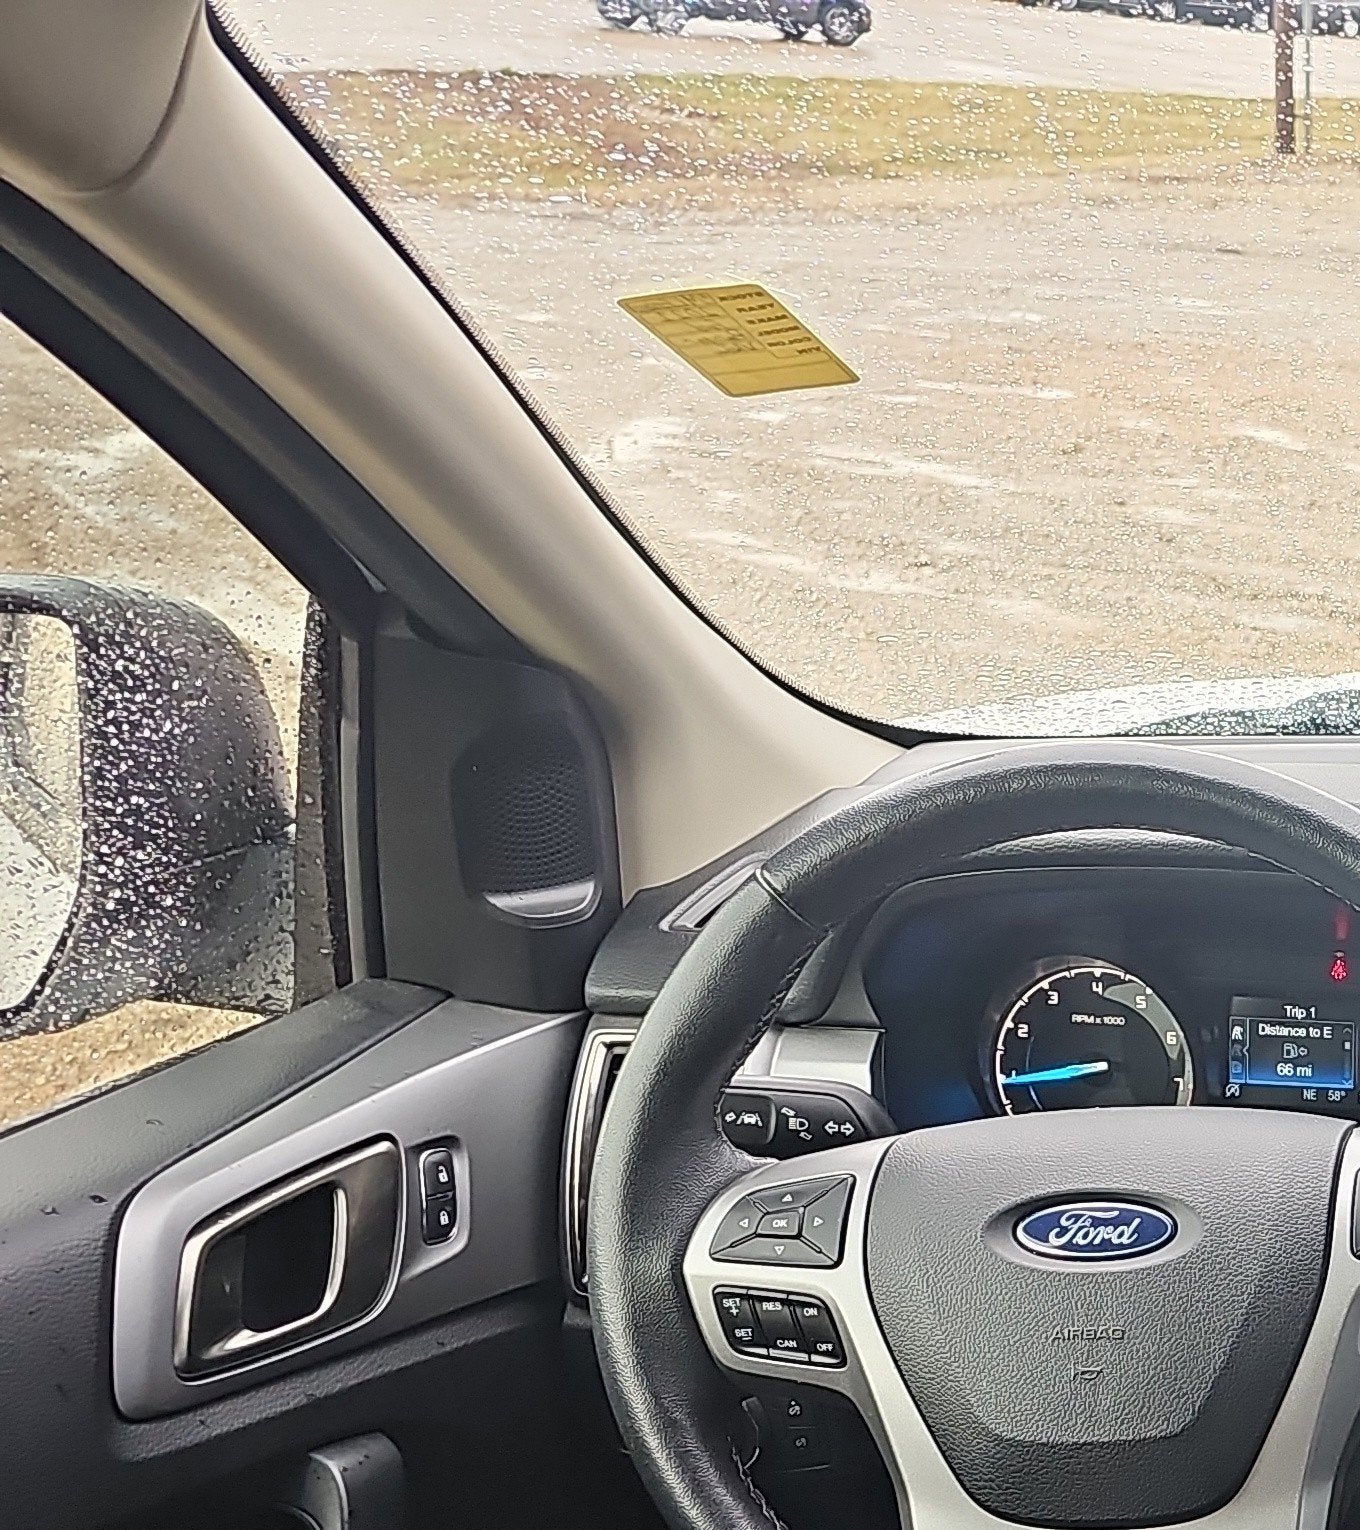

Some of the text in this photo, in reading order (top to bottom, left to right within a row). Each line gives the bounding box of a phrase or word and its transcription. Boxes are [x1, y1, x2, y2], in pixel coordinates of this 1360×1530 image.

[1092, 981, 1103, 996] 4
[1048, 991, 1059, 1005] 3
[1135, 995, 1147, 1009] 5
[1284, 1005, 1316, 1020] Trip 1
[1071, 1014, 1095, 1024] RPM
[1102, 1016, 1126, 1026] 1000
[1017, 1024, 1029, 1038] 2
[1258, 1023, 1333, 1038] Distance to E
[1166, 1031, 1177, 1045] 6
[1276, 1063, 1313, 1077] 66 mi
[1174, 1077, 1184, 1091] 7
[1303, 1089, 1317, 1101] NE
[772, 1219, 789, 1228] OK
[1049, 1210, 1142, 1247] Ford
[723, 1298, 741, 1308] SET
[762, 1301, 782, 1311] RES
[803, 1308, 818, 1316] ON
[735, 1328, 752, 1338] SET
[1051, 1326, 1126, 1342] AIRBAG
[776, 1339, 797, 1349] CAN
[816, 1343, 834, 1352] OFF
